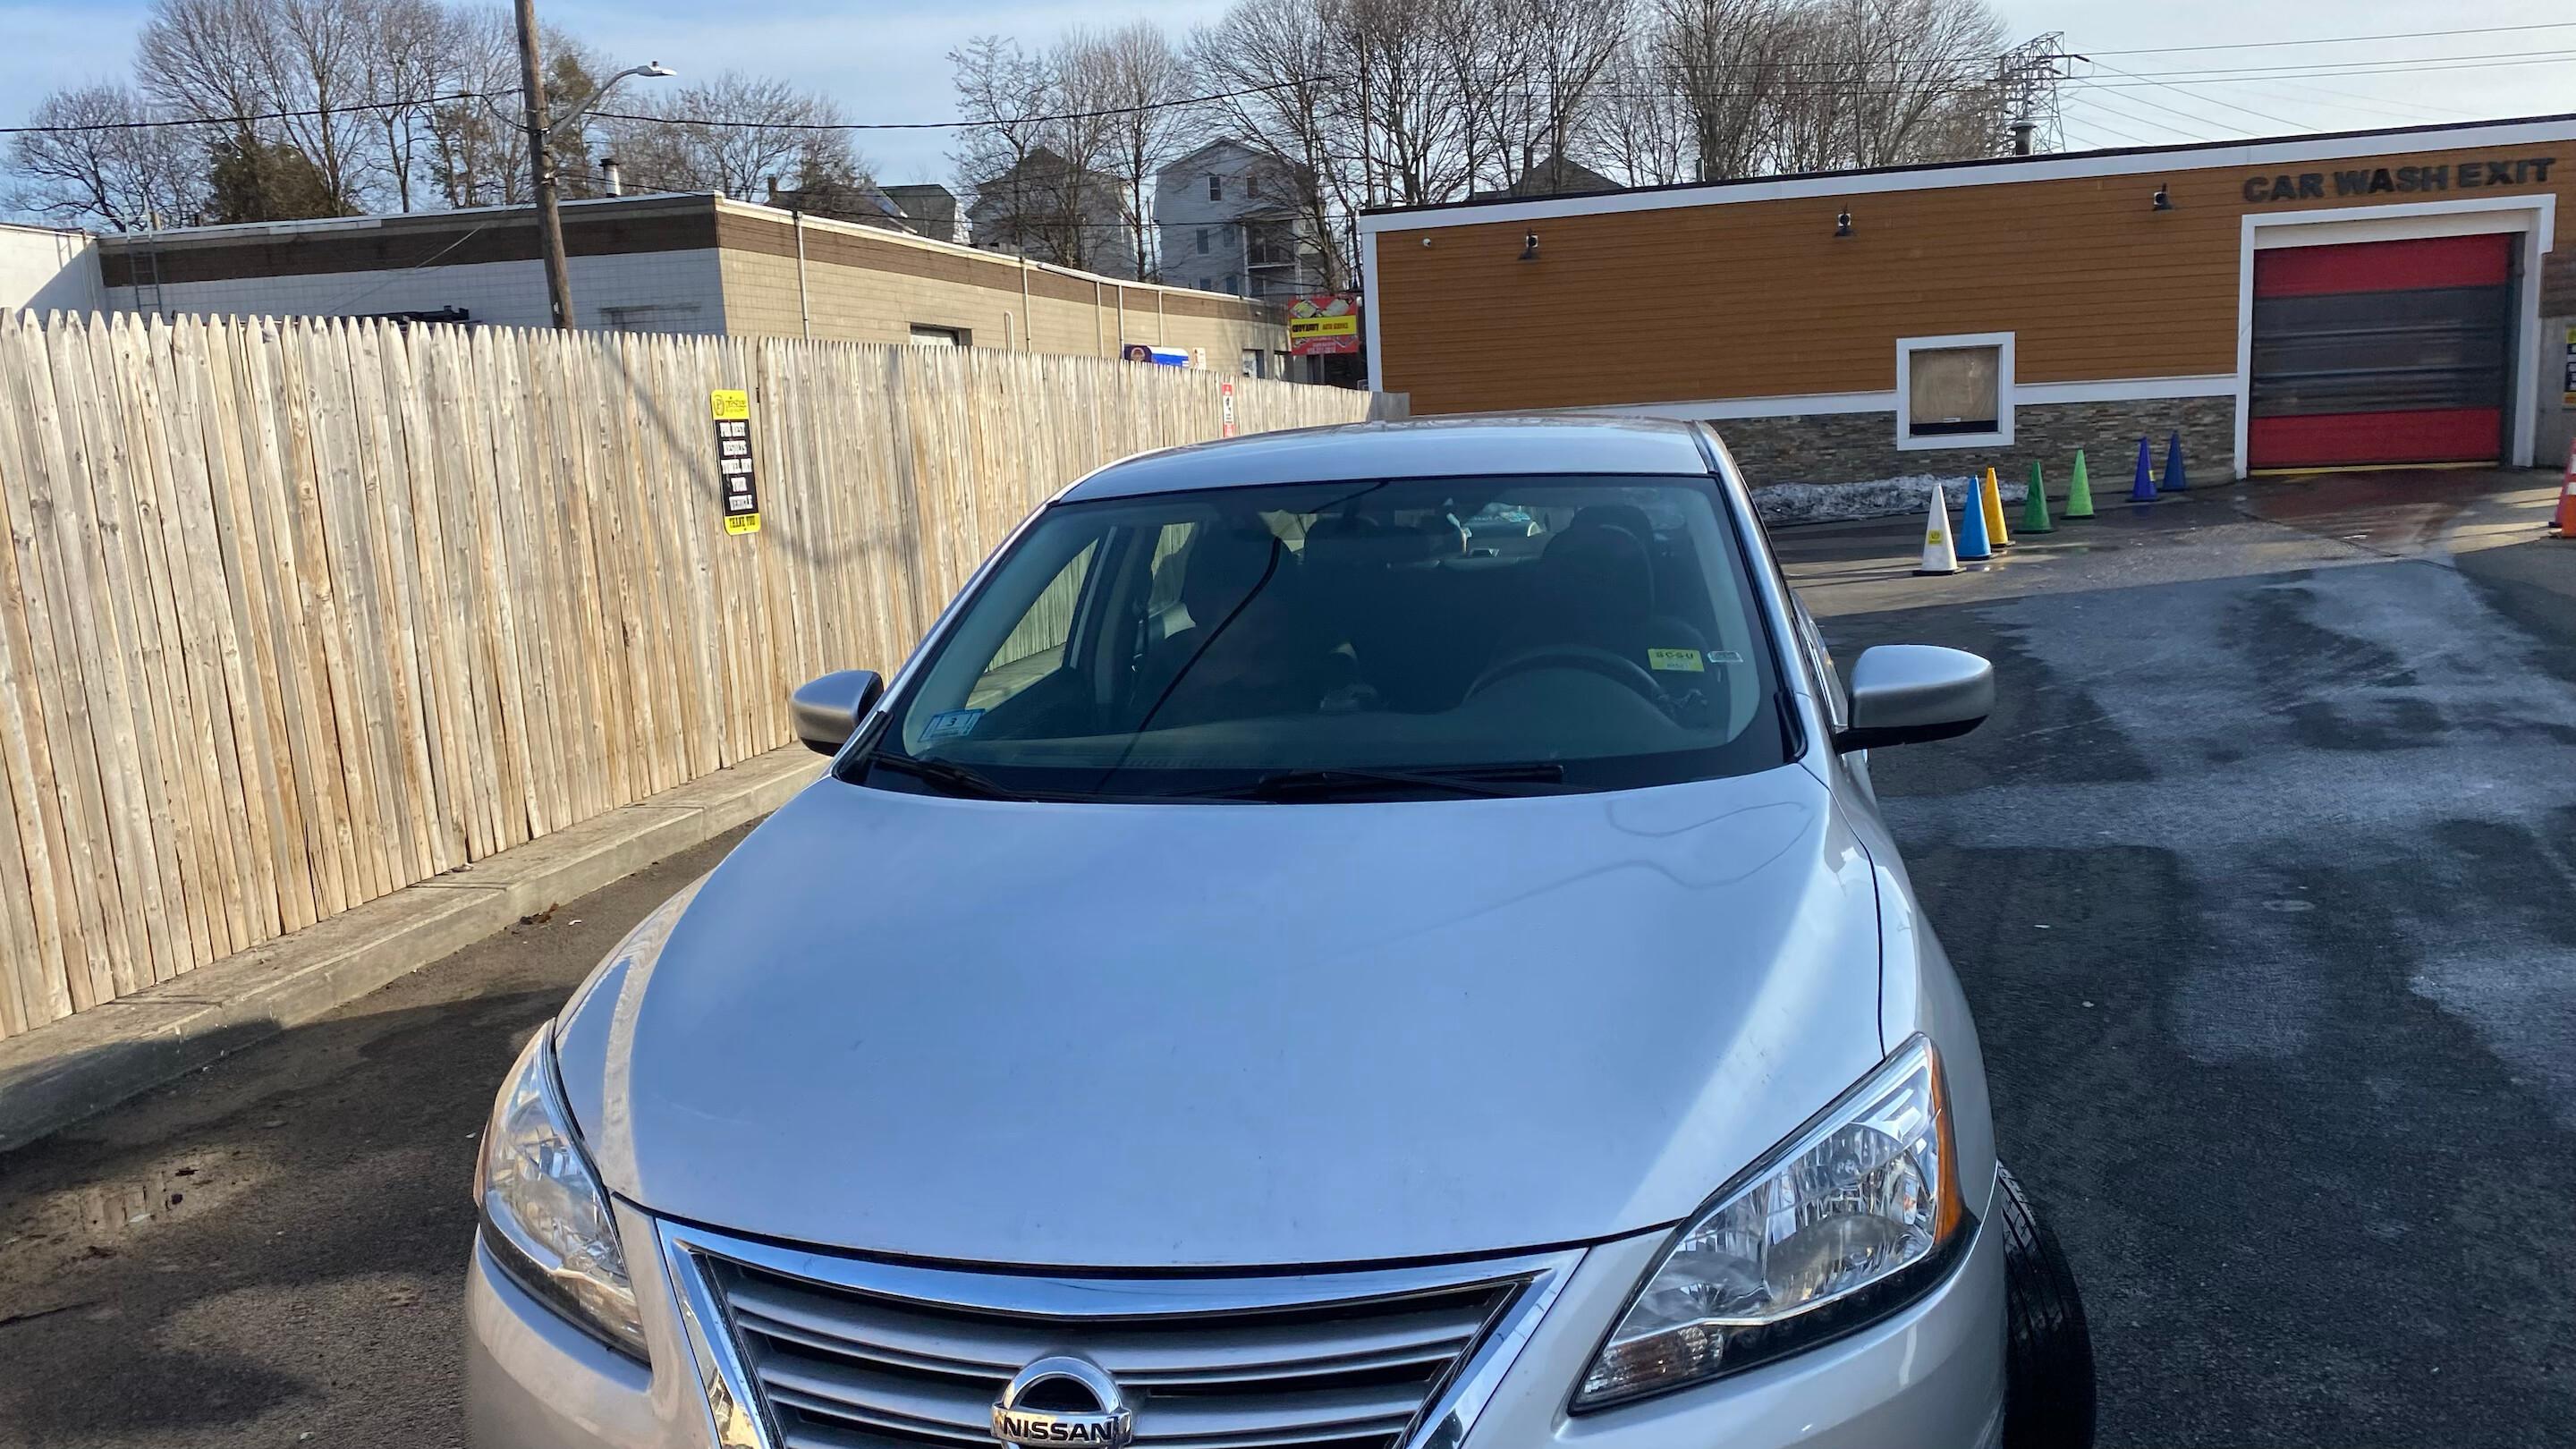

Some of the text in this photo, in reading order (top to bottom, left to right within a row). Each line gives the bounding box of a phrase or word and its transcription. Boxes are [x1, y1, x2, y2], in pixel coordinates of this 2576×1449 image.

[2244, 157, 2556, 202] CAR WASH EXIT
[1003, 1416, 1112, 1441] NISSAN
